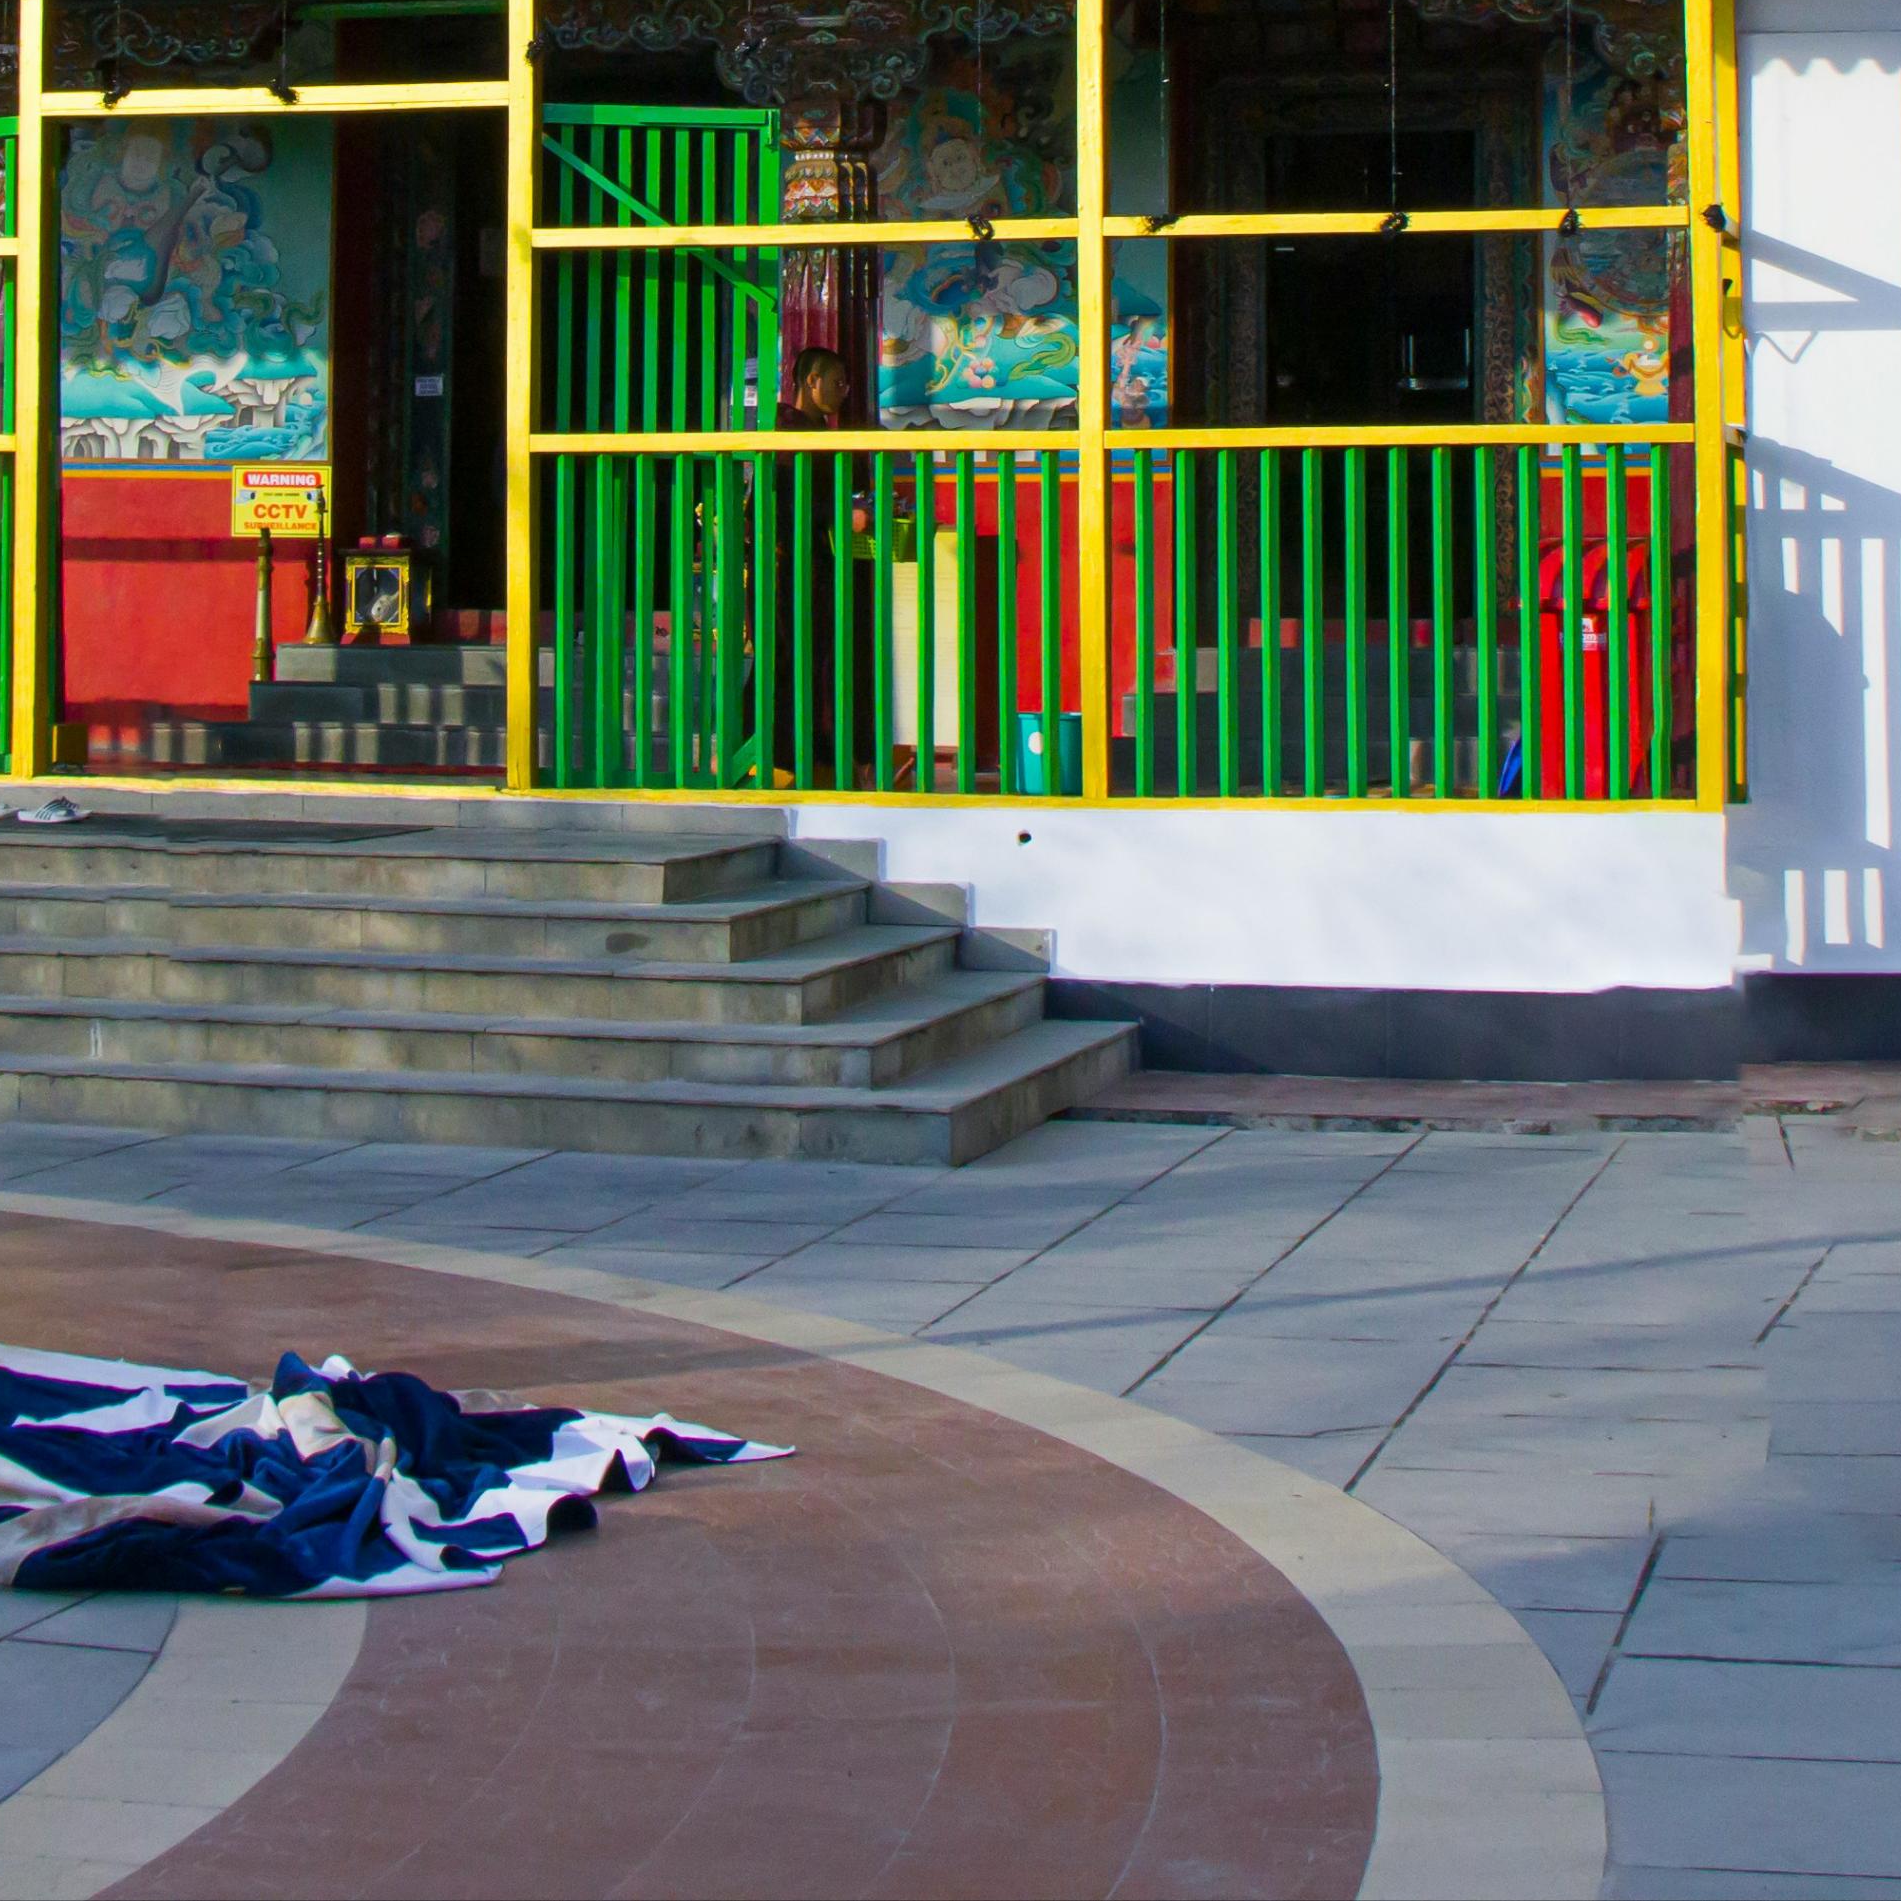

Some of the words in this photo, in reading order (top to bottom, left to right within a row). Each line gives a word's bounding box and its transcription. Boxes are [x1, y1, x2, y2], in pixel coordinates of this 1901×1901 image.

[247, 474, 317, 486] WARNING
[253, 504, 308, 519] CCTV
[244, 522, 317, 530] SURVEILLANCE
